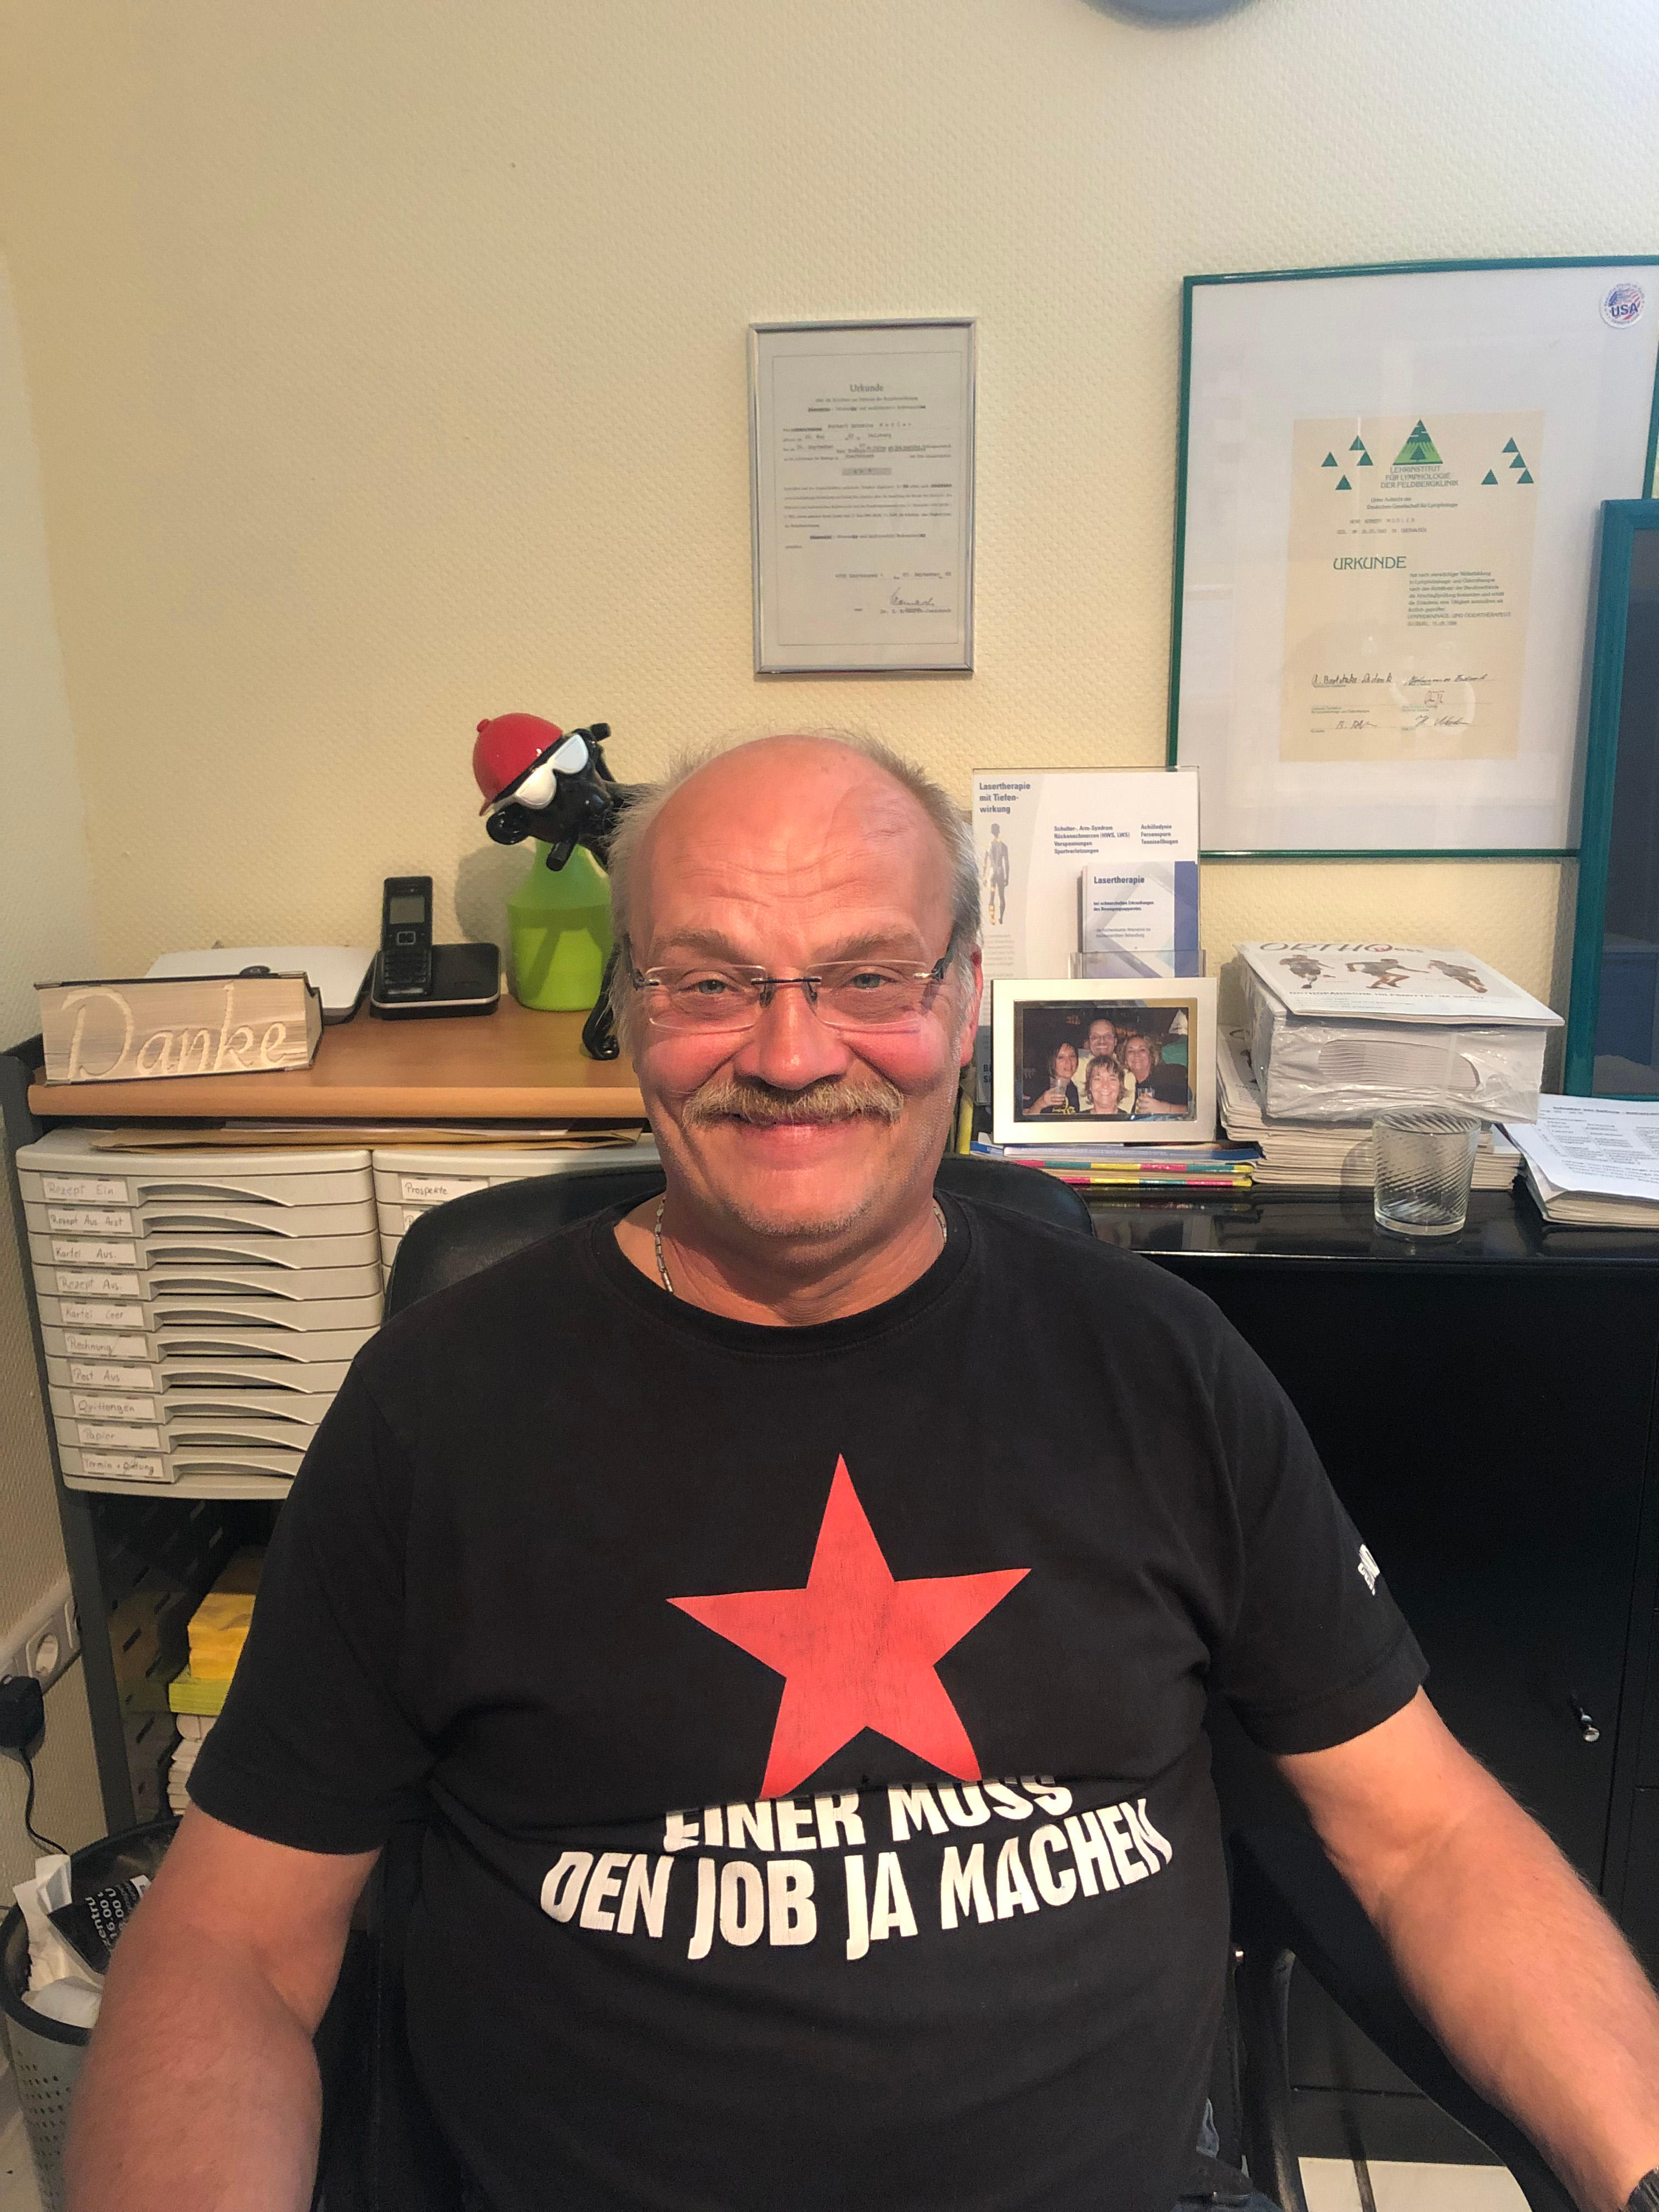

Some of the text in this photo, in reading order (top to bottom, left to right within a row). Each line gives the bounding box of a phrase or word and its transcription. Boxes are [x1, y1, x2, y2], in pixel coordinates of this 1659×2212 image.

[1611, 303, 1638, 317] USA
[850, 384, 884, 392] Urkunde
[1400, 472, 1452, 481] LYMPHOLOGIE
[1398, 480, 1459, 488] FELDBERGKLINIK
[1333, 556, 1407, 571] URKUNDE
[979, 782, 1031, 791] Lasertherapie
[979, 805, 1011, 814] wirkung
[1093, 876, 1145, 885] Lasertherapie
[61, 980, 287, 1080] Danke
[47, 1182, 114, 1196] Rezept Ein
[405, 1182, 448, 1196] Prospekte
[56, 1247, 81, 1257] Kartei
[59, 1274, 94, 1290] Rezept
[66, 1307, 93, 1318] Kartei
[74, 1367, 93, 1381] Post
[83, 1427, 115, 1442] Papier
[663, 1776, 1074, 1853] EINER MUSS
[541, 1798, 1173, 1960] DEN JOB JA MACHEN
